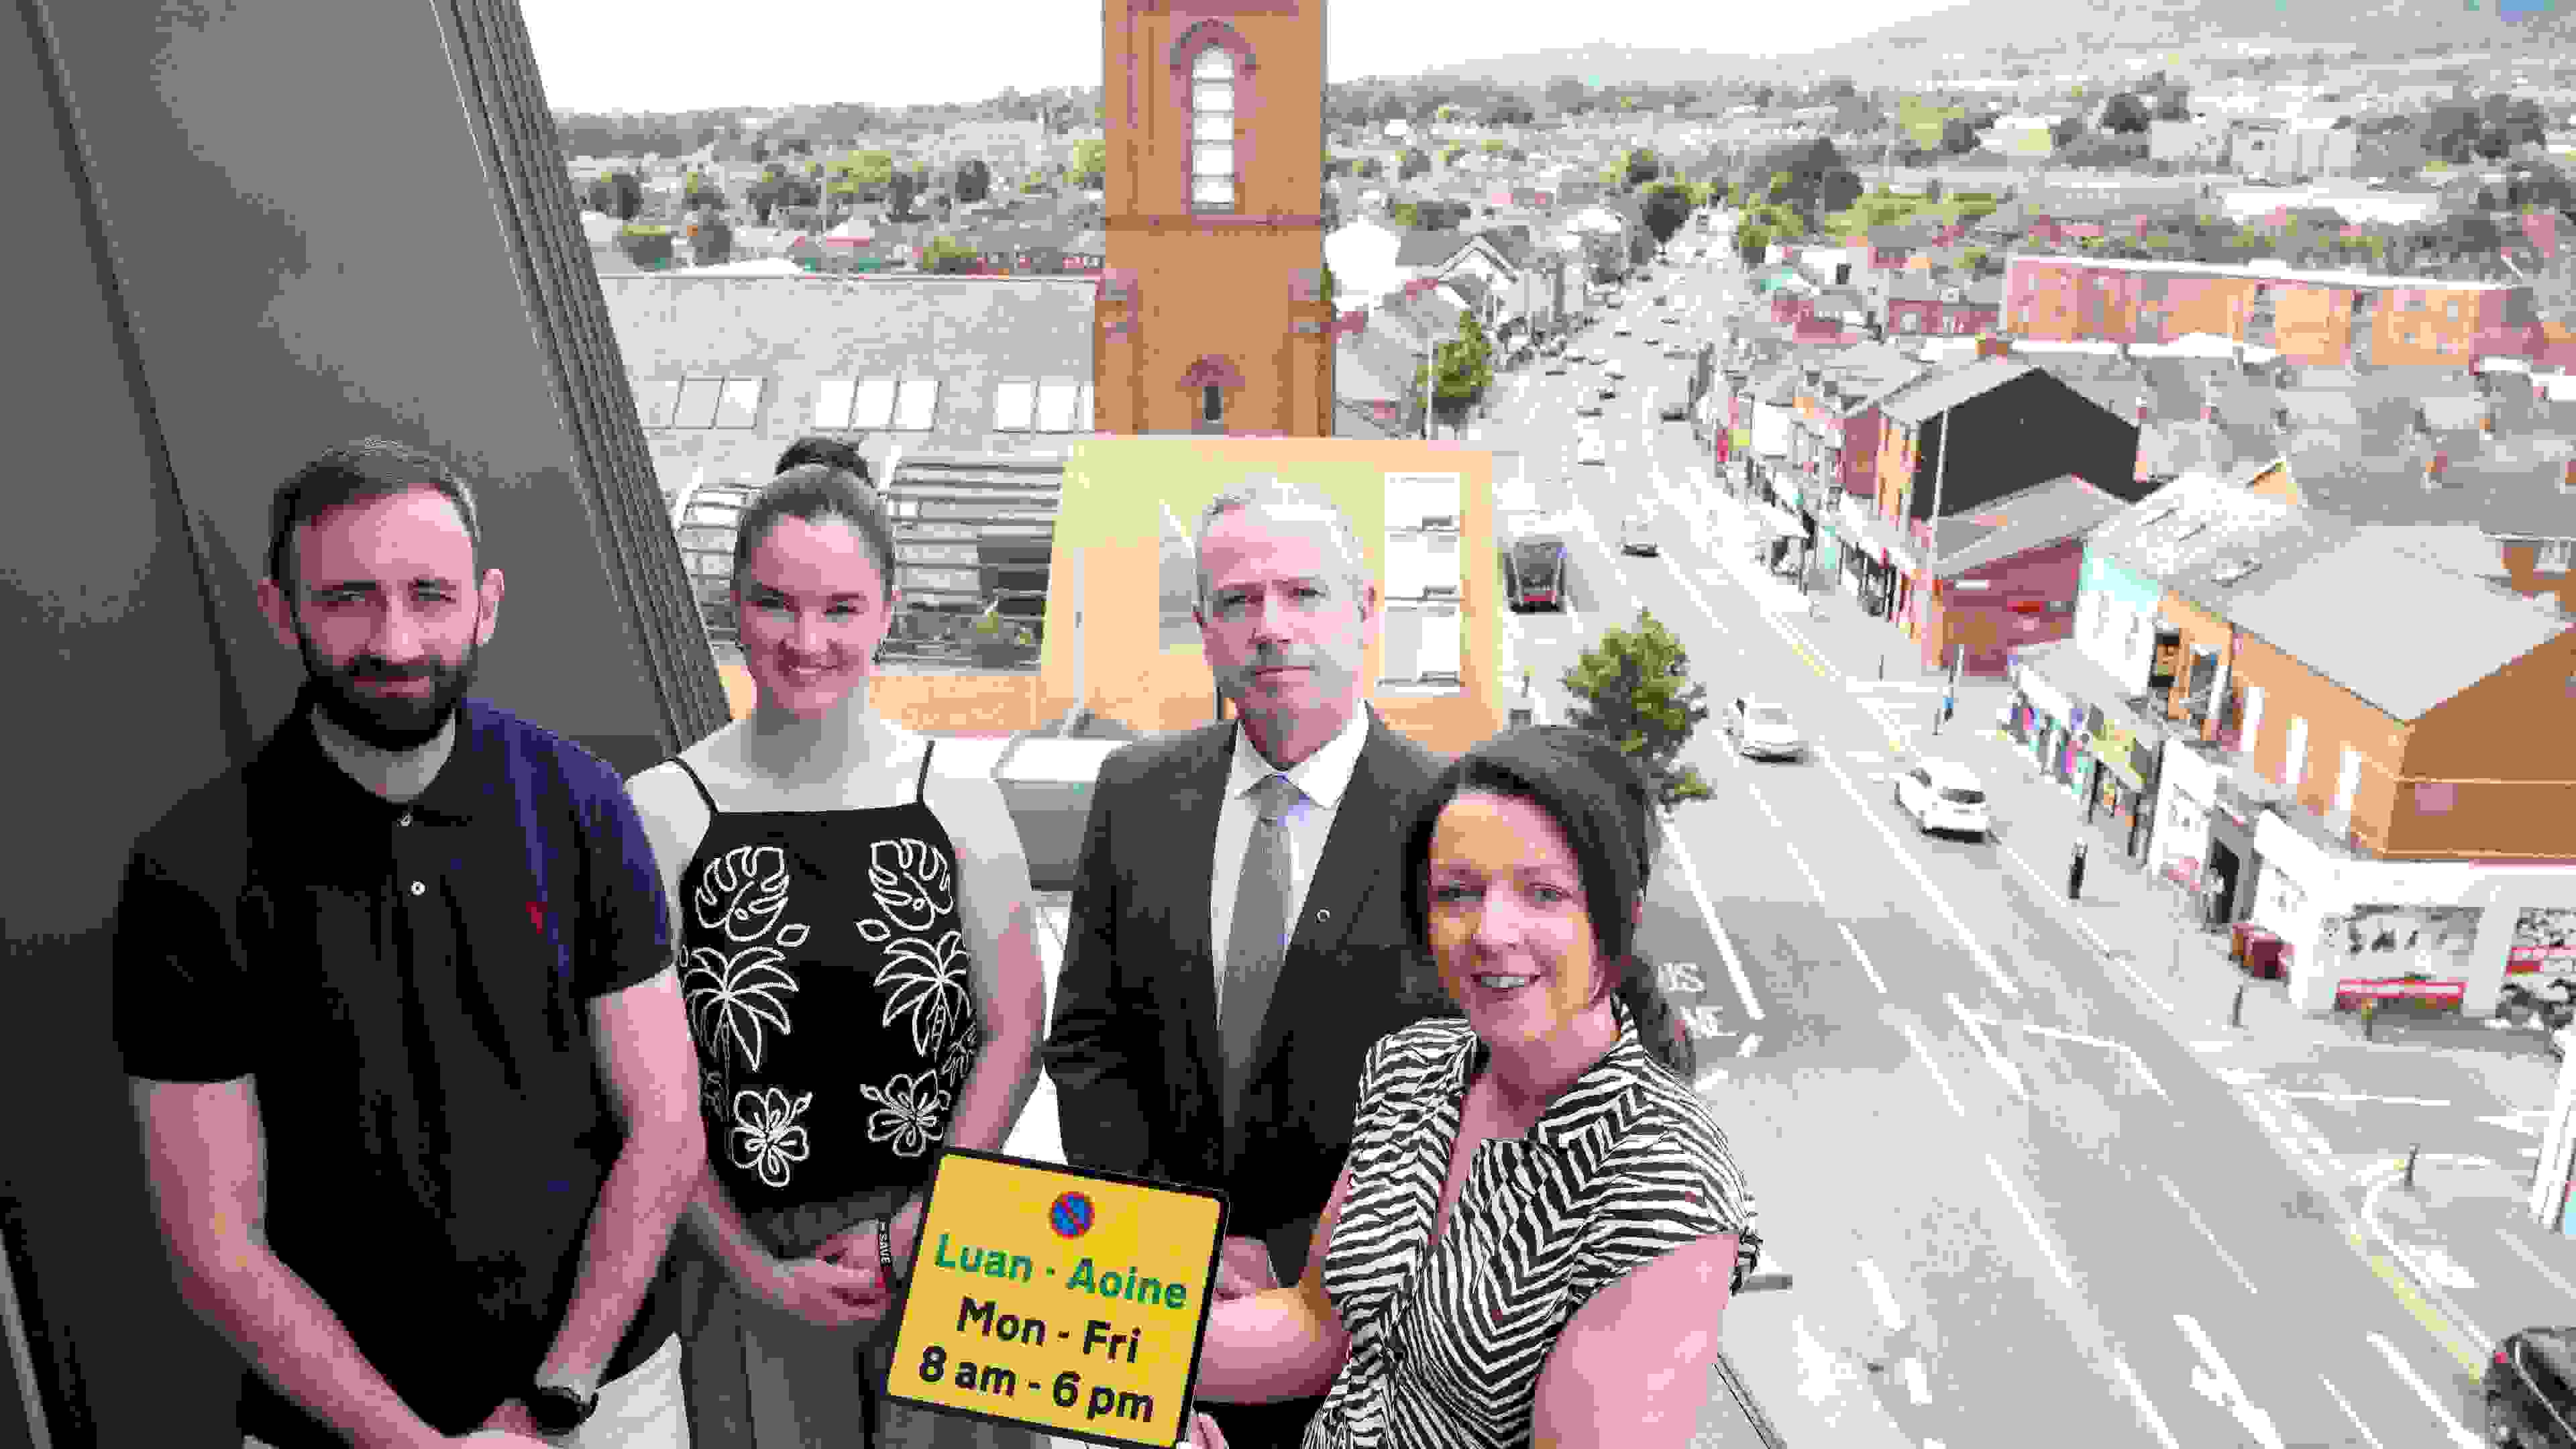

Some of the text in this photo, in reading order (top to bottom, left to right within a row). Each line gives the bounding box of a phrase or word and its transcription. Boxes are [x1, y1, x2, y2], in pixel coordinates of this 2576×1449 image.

[935, 1233, 1032, 1283] Luan
[1067, 1256, 1187, 1309] Aoine
[957, 1297, 1045, 1346] Mon
[1083, 1321, 1141, 1364] Fri
[919, 1345, 947, 1383] 8
[955, 1362, 1016, 1399] am
[1053, 1372, 1081, 1408] 6
[1086, 1386, 1154, 1423] pm
